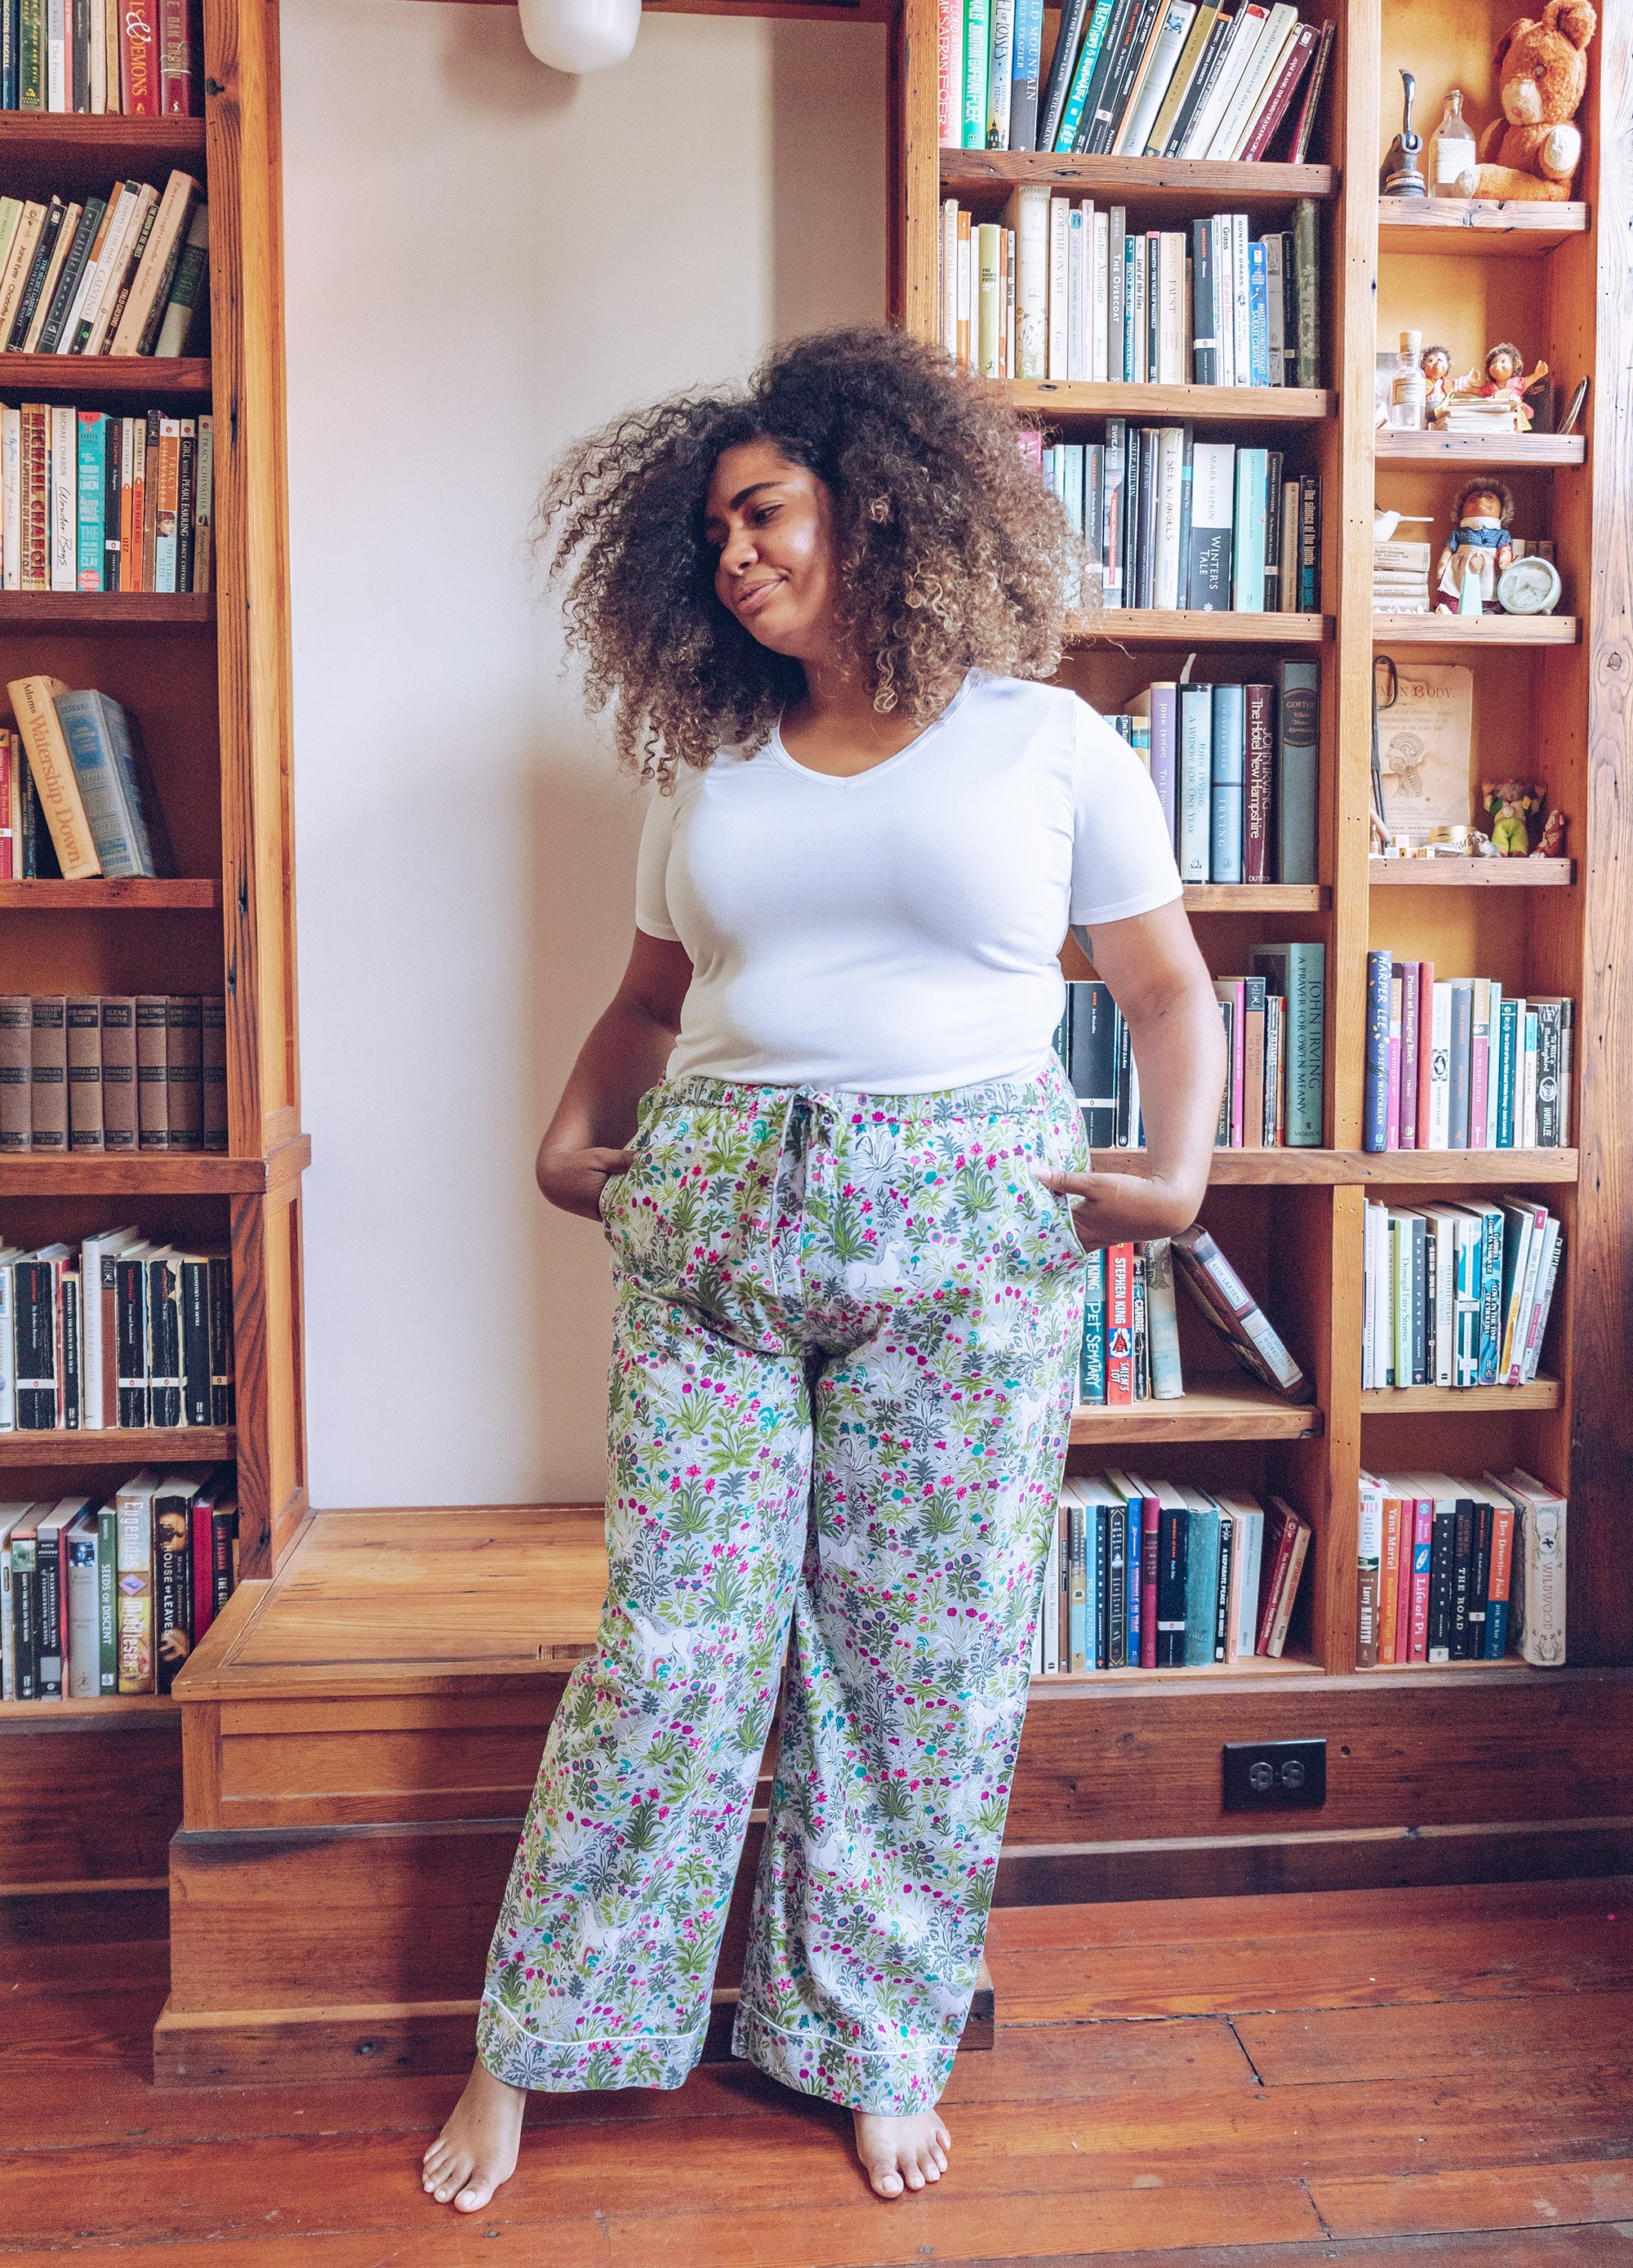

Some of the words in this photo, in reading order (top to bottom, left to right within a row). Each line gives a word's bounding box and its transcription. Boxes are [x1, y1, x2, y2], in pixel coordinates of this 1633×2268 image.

[1069, 16, 1078, 32] THE
[1277, 10, 1287, 24] our
[994, 22, 1012, 60] LOSSES
[1017, 27, 1026, 68] FRAZIER
[1065, 32, 1075, 47] END
[1263, 25, 1281, 53] endless
[129, 34, 148, 96] DEMONS
[1026, 25, 1040, 101] MOUNTAIN
[1057, 63, 1067, 82] LANE
[1245, 54, 1267, 93] numbered
[1049, 90, 1061, 110] NEIL
[1237, 94, 1251, 111] days
[1042, 111, 1056, 144] GAIMAN
[1055, 207, 1066, 252] GOETHE
[16, 244, 27, 263] Jane
[1055, 255, 1065, 272] ON
[1113, 254, 1121, 272] THE
[1137, 258, 1145, 271] Lord
[11, 264, 21, 278] Eyre
[35, 270, 45, 292] SECRET
[84, 270, 105, 316] CALVINO
[118, 287, 129, 305] ITALO
[1055, 276, 1065, 297] ART
[1112, 276, 1121, 323] OVERCOAT
[1137, 283, 1145, 292] the
[1168, 279, 1177, 314] FAUST
[110, 304, 125, 328] CALVINO
[1136, 295, 1145, 310] Flies
[1251, 310, 1259, 329] SARAH
[1252, 332, 1260, 368] GRAVES
[30, 412, 46, 497] MICHAEL
[182, 440, 193, 459] GIRL
[201, 436, 209, 464] TRACY
[159, 441, 167, 504] CHEVALIER
[1166, 460, 1175, 480] SEE
[1208, 454, 1217, 482] MARK
[180, 479, 192, 501] PEARL
[200, 466, 208, 510] CHEVALIER
[1208, 485, 1217, 520] HELPRIN
[1304, 501, 1315, 525] silence
[180, 503, 190, 537] EARRING
[1164, 502, 1175, 541] ANGELS
[30, 500, 46, 579] CHABON
[56, 535, 73, 567] Boys
[1304, 534, 1315, 545] the
[1199, 549, 1210, 576] TALE
[1209, 535, 1221, 590] WINTER'S
[1303, 546, 1315, 566] lambs
[23, 682, 38, 714] Adams
[1251, 697, 1263, 720] The
[1159, 702, 1168, 725] JOHN
[1188, 715, 1196, 724] A
[1159, 729, 1168, 758] IRVING
[1187, 726, 1196, 763] WIDOW
[1251, 720, 1263, 750] Hotel
[1261, 727, 1273, 764] JOHN
[29, 712, 65, 804] Watership
[1197, 742, 1206, 767] JOHN
[1251, 751, 1262, 778] New
[1159, 770, 1168, 786] THE
[1188, 766, 1196, 784] FOR
[1198, 771, 1206, 807] IRVING
[1261, 765, 1273, 809] IRVING
[1188, 788, 1196, 809] ONE
[1248, 779, 1262, 839] Hampshire
[54, 807, 81, 863] Down
[1186, 813, 1195, 835] YEAR
[1217, 799, 1226, 848] IRVING
[1297, 956, 1306, 965] A
[1297, 967, 1306, 1005] PRAYER
[1377, 956, 1389, 1003] HARPER
[1407, 974, 1415, 999] Picnic
[1308, 980, 1321, 1024] JOHN
[1407, 1000, 1415, 1009] at
[1297, 1009, 1306, 1031] FOR
[1377, 1009, 1387, 1029] LEE
[1404, 1010, 1415, 1043] Hanging
[1297, 1034, 1306, 1069] OWEN
[1308, 1031, 1321, 1089] IRVING
[1406, 1044, 1414, 1064] Rock
[1296, 1073, 1306, 1114] MEANY
[1376, 1081, 1386, 1125] WATCHMAN
[1542, 1107, 1551, 1125] HARPER
[1542, 1125, 1551, 1137] LEE
[1088, 1264, 1101, 1290] KING
[1114, 1257, 1127, 1299] STEPHEN
[1400, 1257, 1410, 1292] Donegal
[1222, 1277, 1241, 1303] LARSEN
[1400, 1293, 1410, 1314] Fairy
[1085, 1300, 1101, 1332] PET
[1114, 1300, 1127, 1325] KING
[1134, 1299, 1144, 1334] CARRIE
[1401, 1314, 1410, 1343] Stories
[1084, 1334, 1103, 1388] SEMATARY
[1110, 1369, 1120, 1383] LOT
[1387, 1508, 1399, 1533] Yann
[163, 1545, 172, 1583] HOUSE
[1386, 1535, 1397, 1571] Martel
[101, 1564, 111, 1591] SEEDS
[1086, 1578, 1094, 1605] MILAN
[1415, 1578, 1426, 1602] Life
[1457, 1566, 1466, 1592] THE
[1361, 1586, 1373, 1604] Larry
[1542, 1561, 1553, 1630] WILDWOOD
[163, 1595, 173, 1636] LEAVES
[1414, 1604, 1425, 1617] of
[1456, 1597, 1465, 1631] ROAD
[101, 1605, 112, 1646] DISCENT
[122, 1599, 143, 1668] Middlesex
[1086, 1606, 1094, 1648] KUNDERA
[1414, 1622, 1425, 1635] Pi
